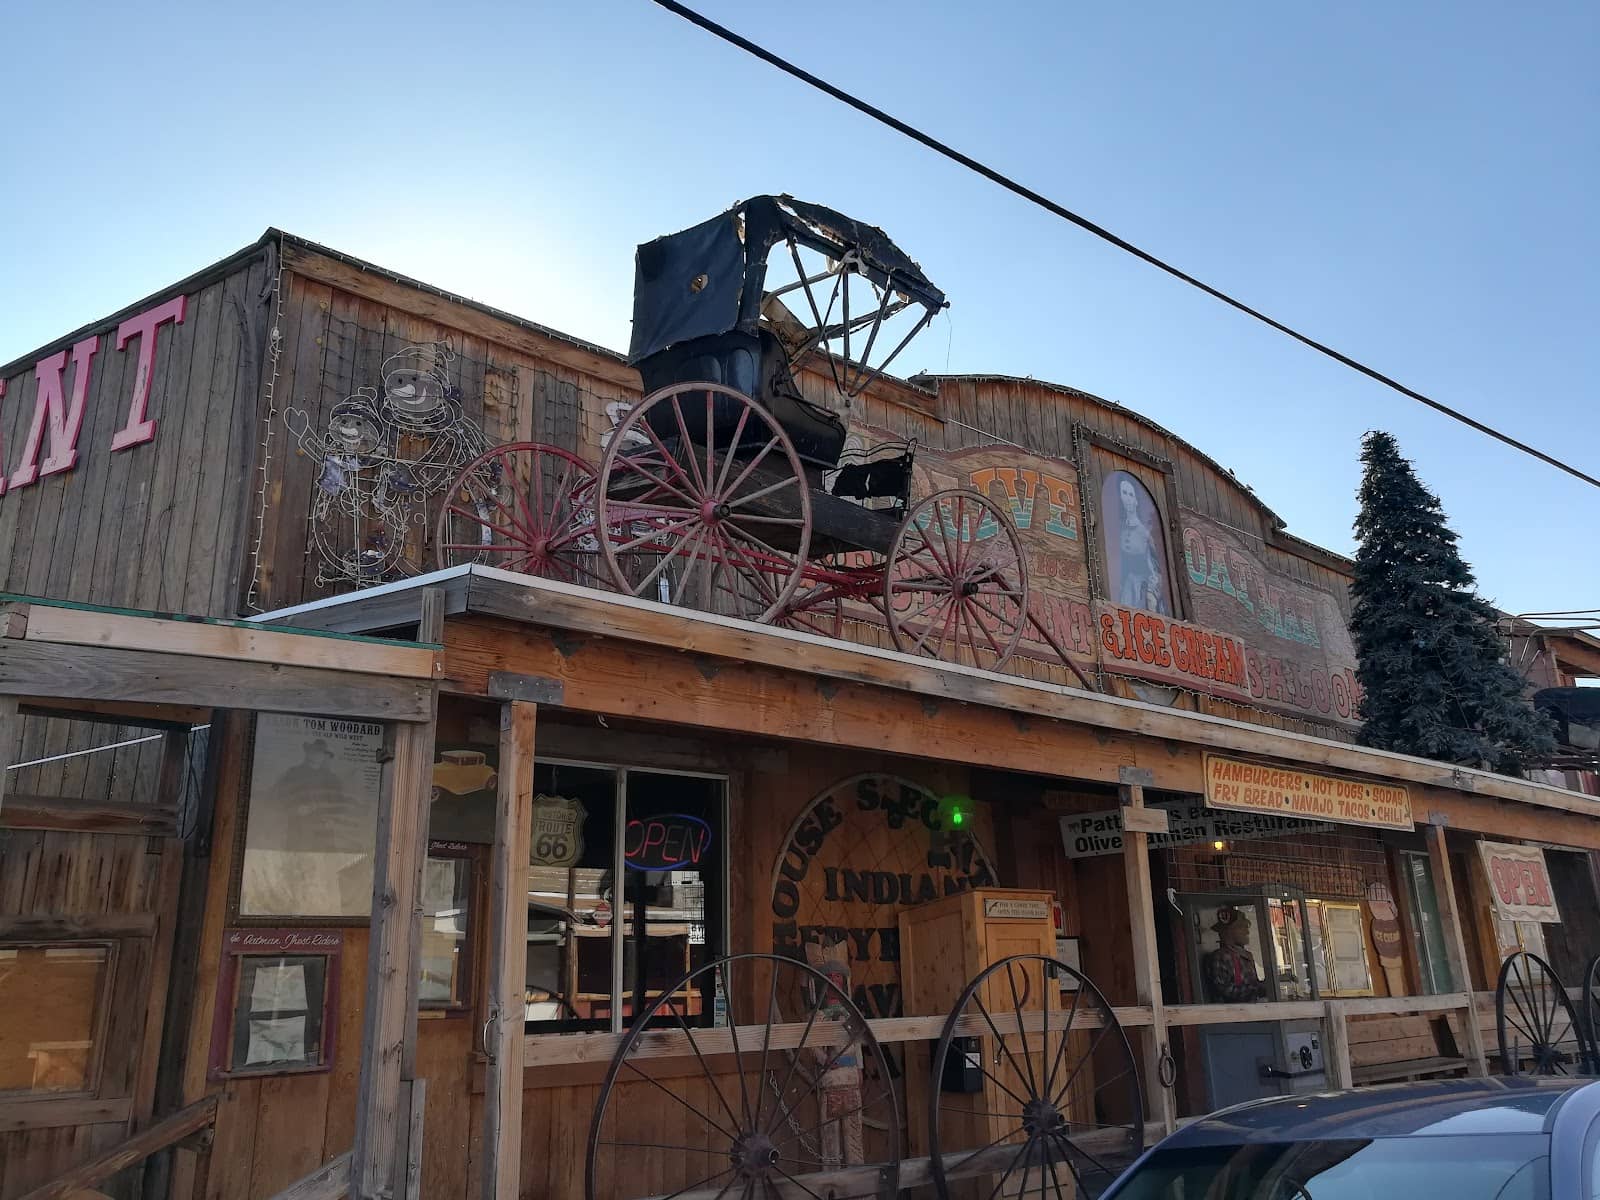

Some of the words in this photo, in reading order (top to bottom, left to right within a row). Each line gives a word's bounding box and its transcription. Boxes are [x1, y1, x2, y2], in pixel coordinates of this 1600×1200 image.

[0, 295, 187, 495] NT
[1182, 527, 1322, 649] OATMAN
[1117, 609, 1171, 667] ICE
[1169, 624, 1248, 690] CREAM
[303, 719, 326, 731] TOM
[330, 721, 381, 736] WOODARD
[1213, 762, 1303, 791] HAMBURGERS
[1312, 778, 1335, 796] HOT
[1336, 782, 1364, 801] DOGS
[1373, 787, 1403, 806] SODAS
[1213, 784, 1240, 802] FRY
[1243, 788, 1283, 807] BREAD
[1291, 794, 1334, 816] NAVAJO
[1338, 800, 1370, 820] TACOS
[1377, 807, 1404, 823] CHILI
[536, 833, 569, 859] 66
[537, 821, 574, 835] ROUTE
[624, 820, 705, 863] OPEN
[1075, 835, 1123, 853] Olive
[1147, 824, 1207, 845] atman
[1489, 855, 1553, 907] OPEN
[280, 933, 310, 950] Ghost
